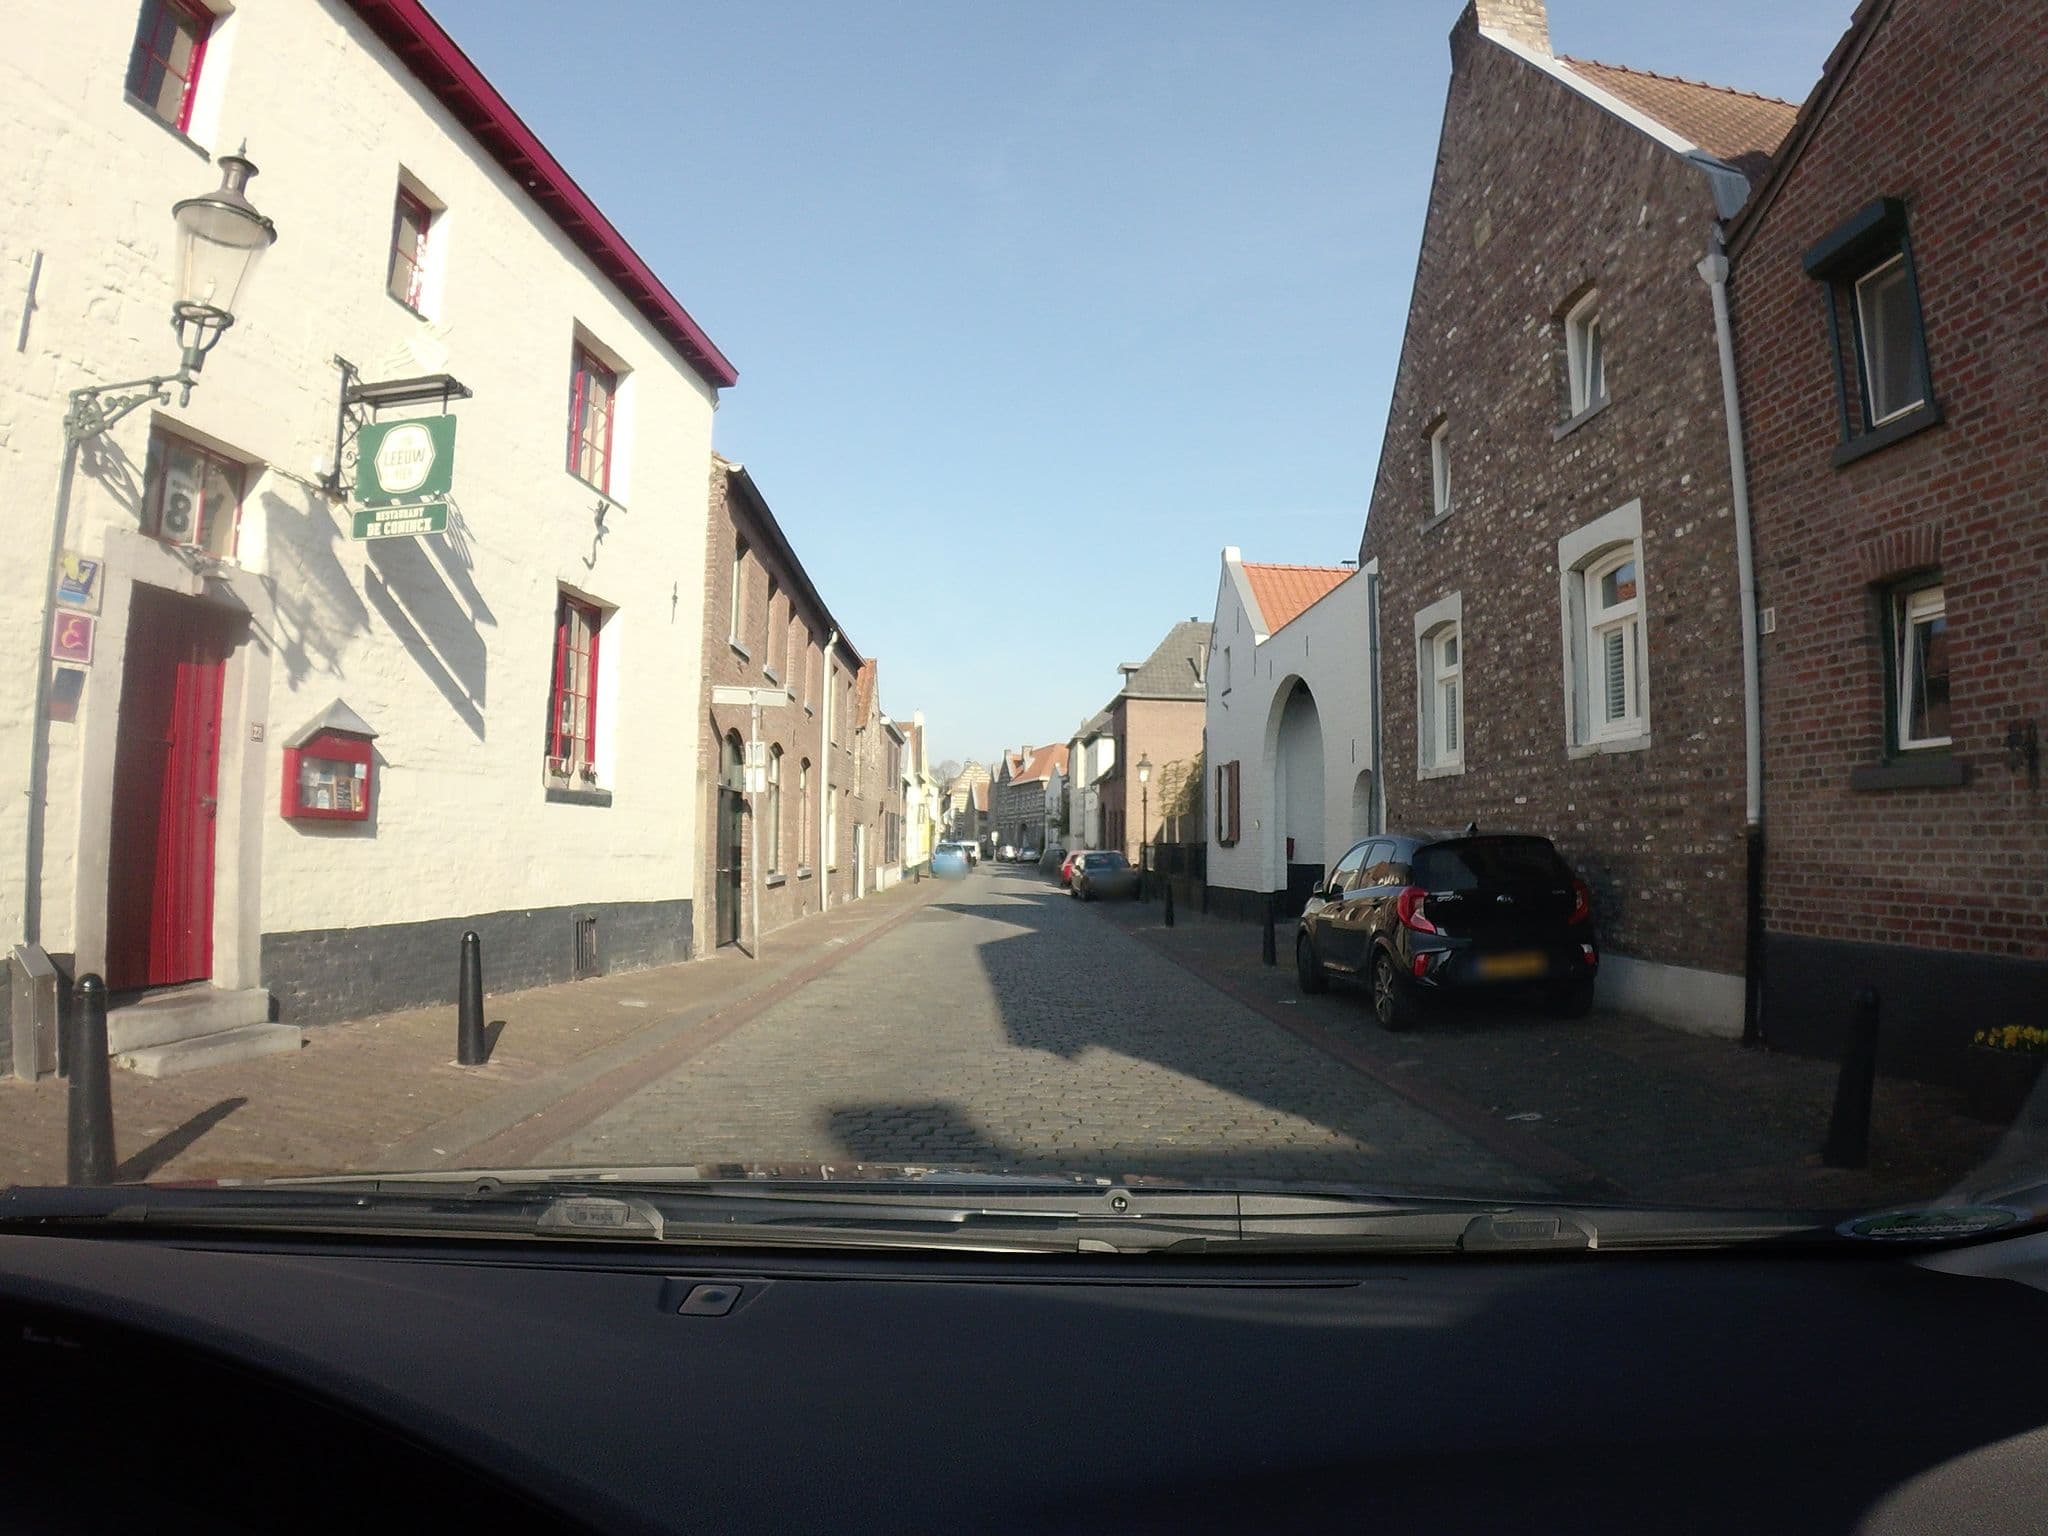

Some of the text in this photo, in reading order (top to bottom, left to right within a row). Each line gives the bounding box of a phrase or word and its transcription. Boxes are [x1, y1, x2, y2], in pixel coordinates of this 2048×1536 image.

[384, 448, 426, 466] LEEUW
[376, 507, 424, 522] RESTAURANT
[367, 523, 381, 537] DE
